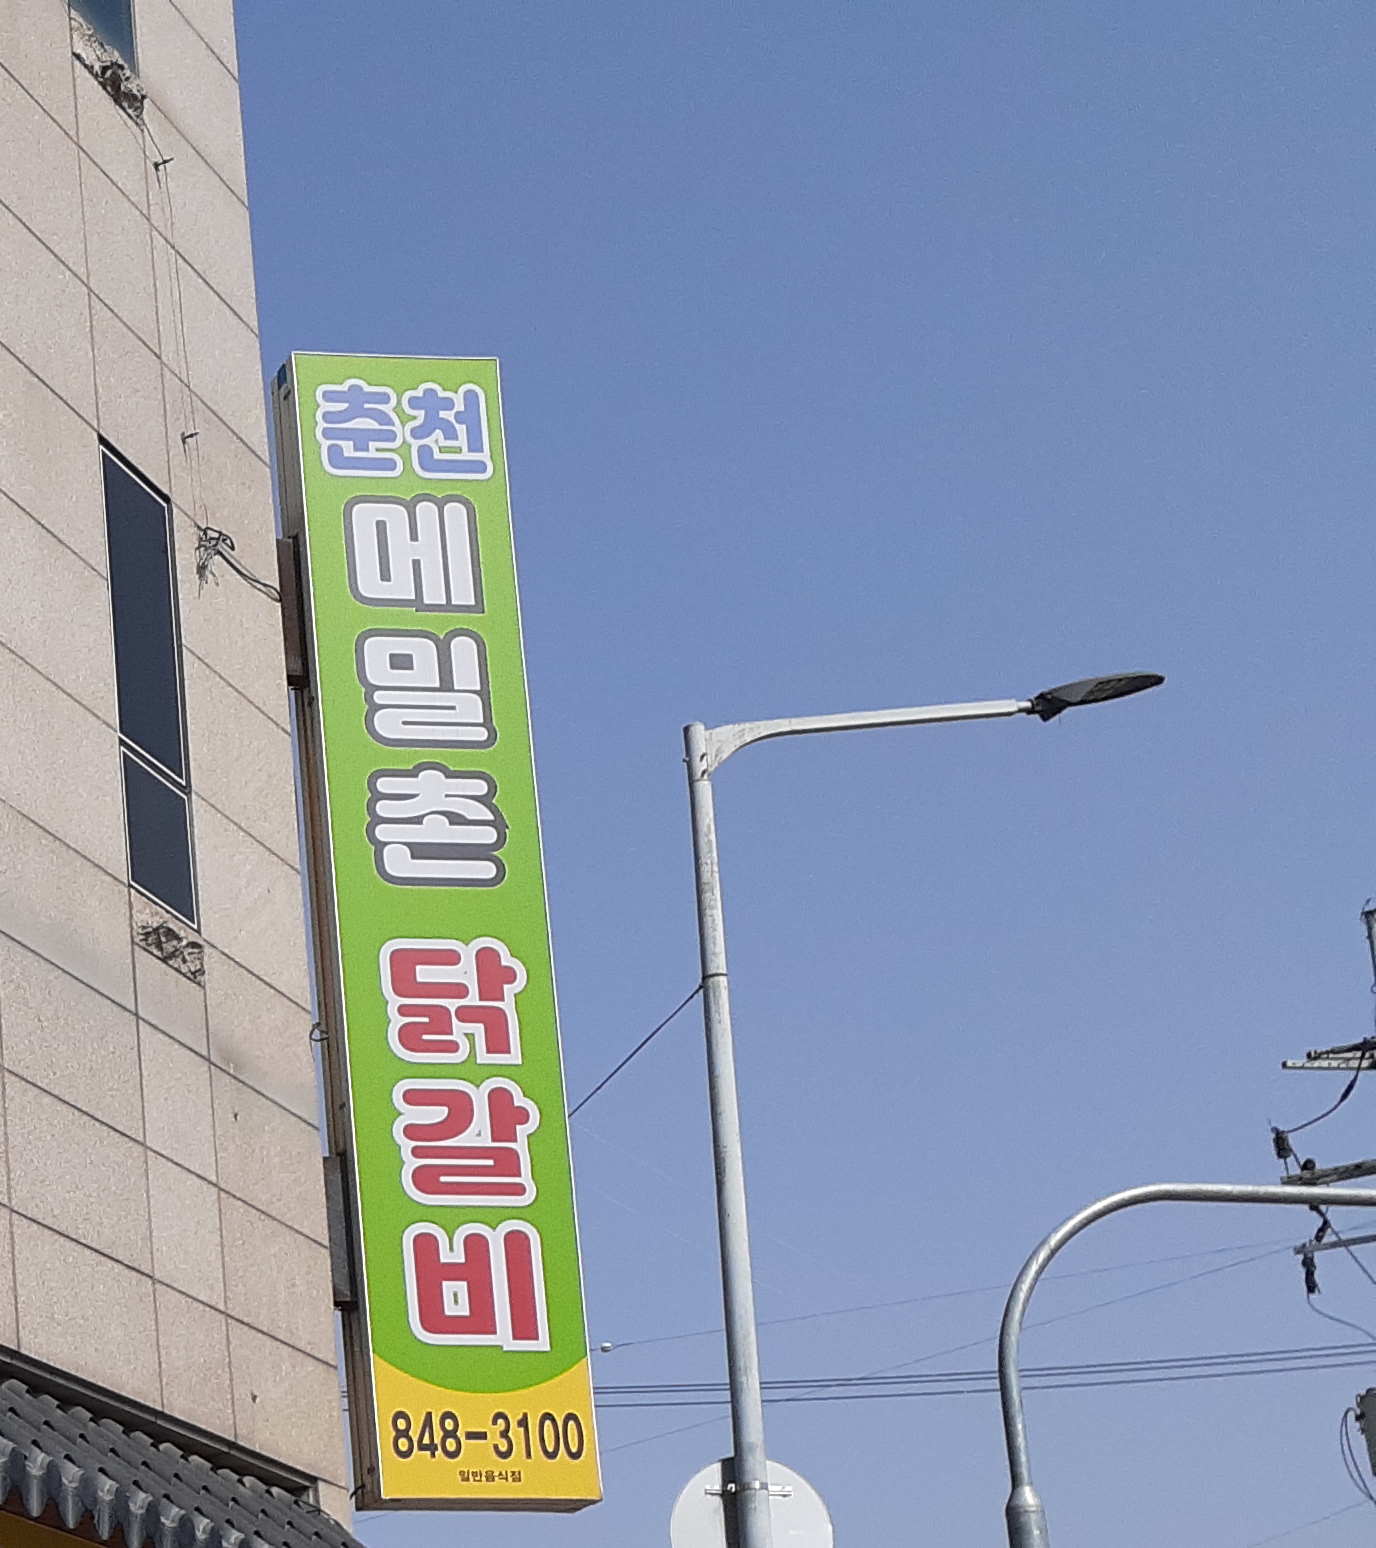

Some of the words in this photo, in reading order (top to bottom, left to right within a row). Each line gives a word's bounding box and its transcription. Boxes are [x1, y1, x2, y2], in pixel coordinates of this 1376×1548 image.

[316, 378, 494, 480] 춘천
[344, 493, 509, 888] 메밀촌
[379, 937, 550, 1351] 닭갈비
[391, 1410, 585, 1461] 848-3100
[458, 1469, 522, 1484] 일반음식점
